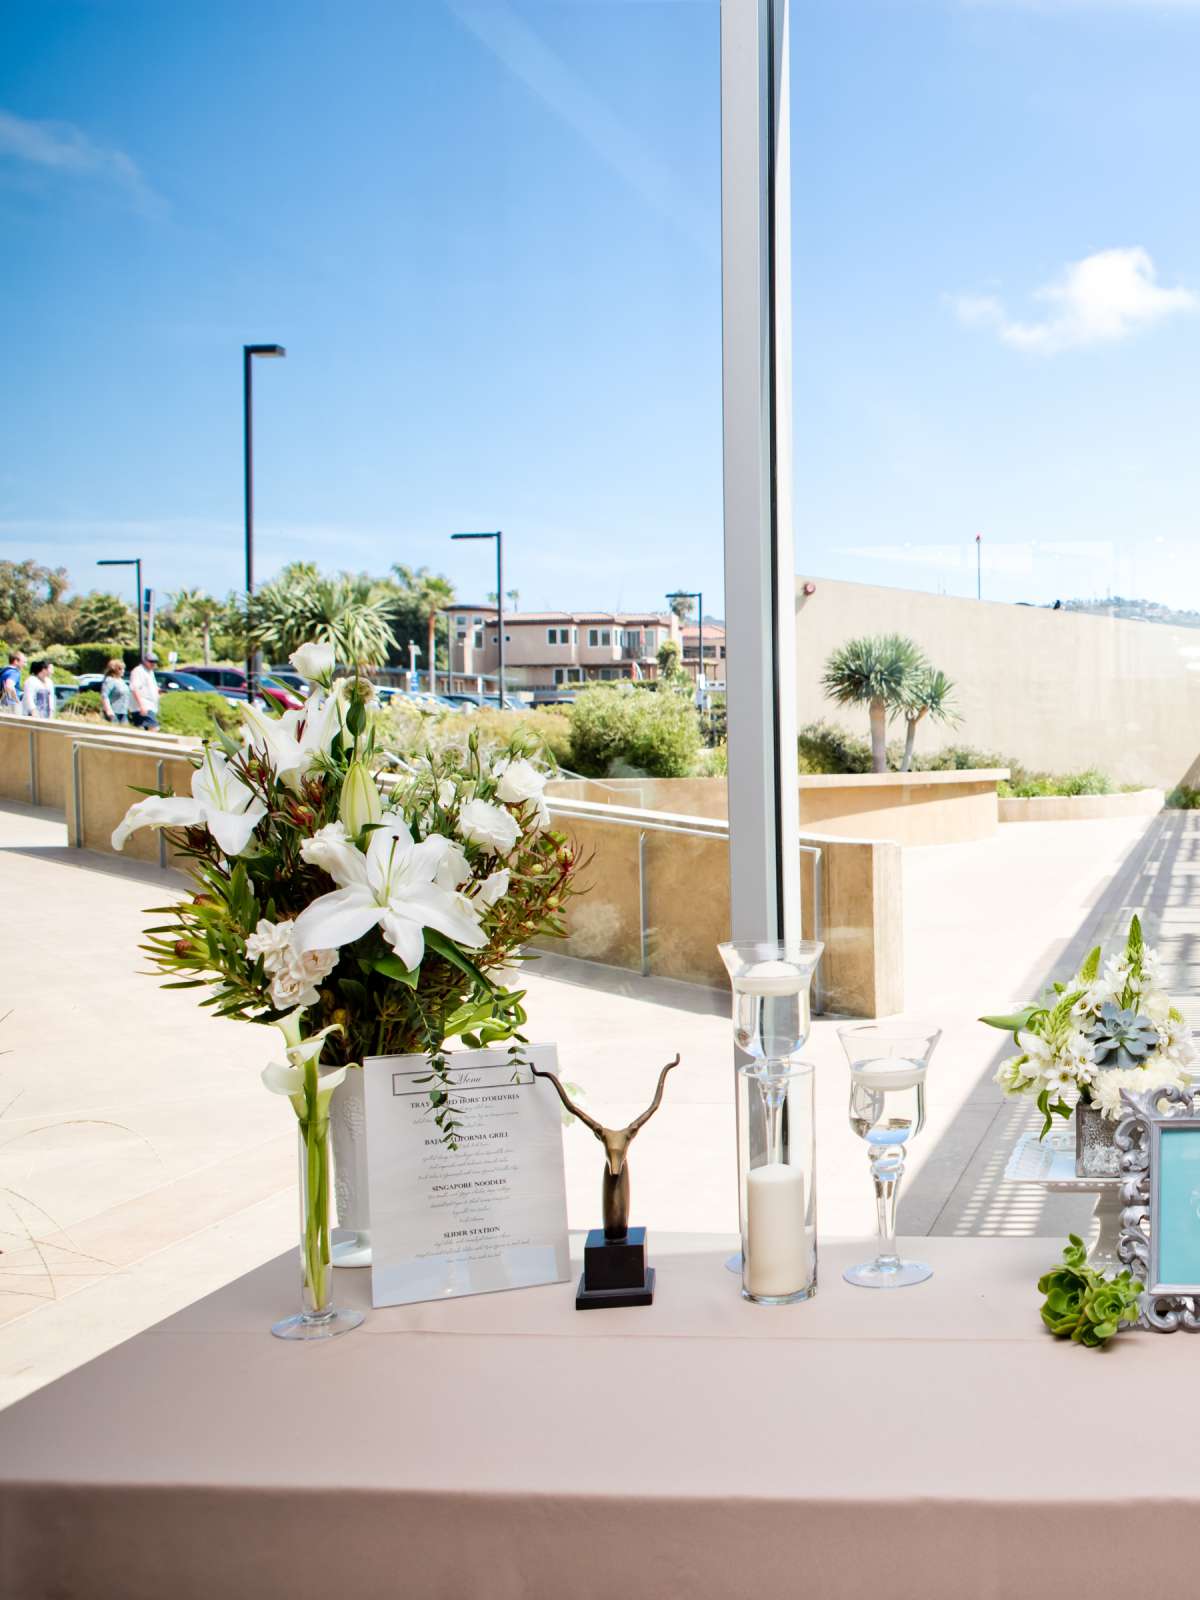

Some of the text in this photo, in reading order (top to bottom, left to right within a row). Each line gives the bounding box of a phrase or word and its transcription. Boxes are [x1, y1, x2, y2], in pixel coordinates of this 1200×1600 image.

[457, 1072, 481, 1083] Menu
[432, 1179, 506, 1192] SINGAPORE NOODLES
[443, 1226, 500, 1238] SLIDER STATION
